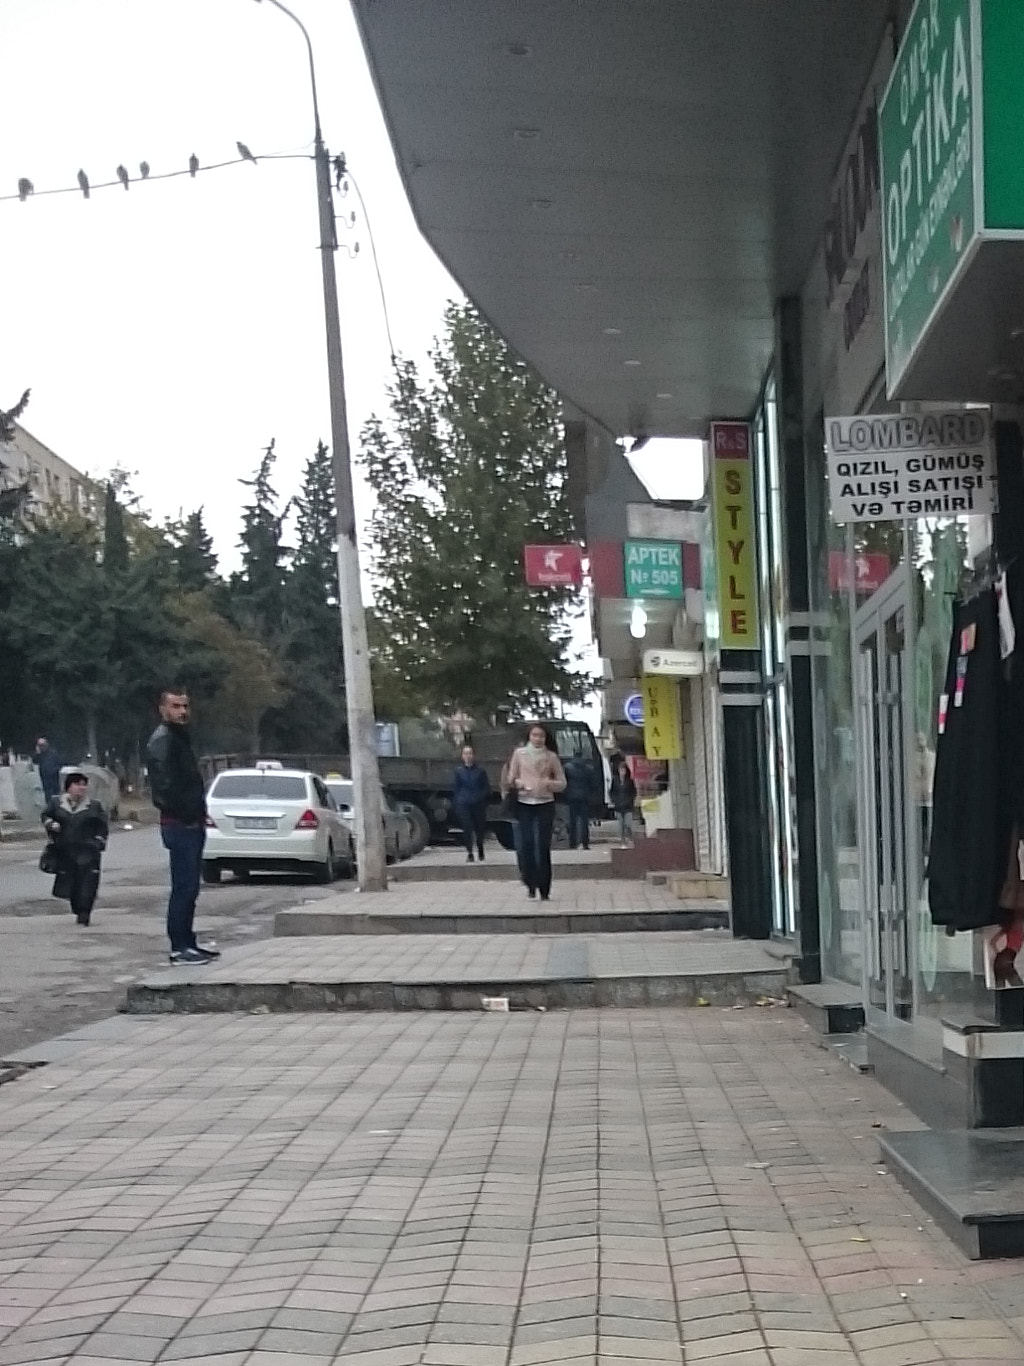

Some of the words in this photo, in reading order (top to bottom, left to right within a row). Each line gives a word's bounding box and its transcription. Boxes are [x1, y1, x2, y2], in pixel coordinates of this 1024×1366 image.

[887, 15, 969, 267] OPTİKA
[831, 413, 985, 452] LOMBARD
[836, 460, 899, 478] QIZIL,
[905, 453, 985, 473] GÜMÜŞ
[839, 480, 900, 499] ALIŞI
[907, 474, 984, 494] SATIŞI
[851, 501, 884, 517] VƏ
[627, 545, 680, 567] APTEK
[724, 469, 748, 635] STYLE
[651, 568, 679, 586] 505
